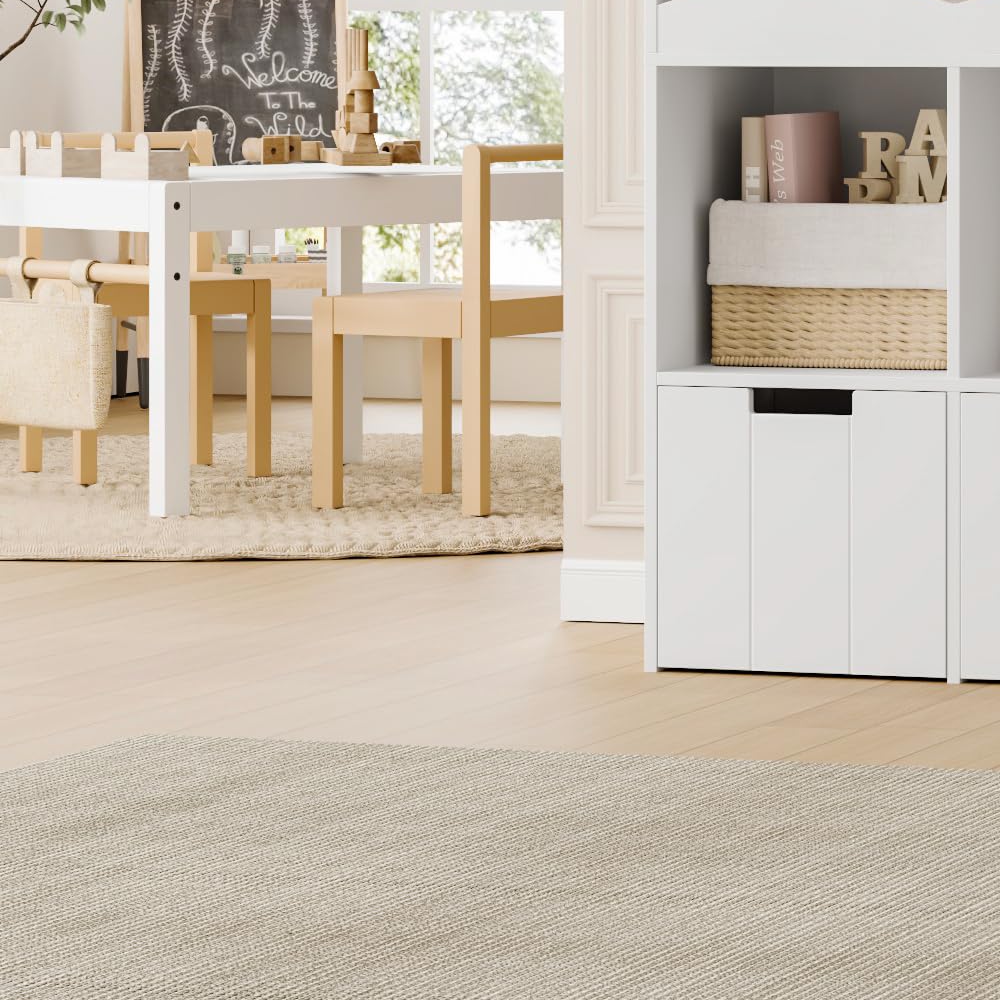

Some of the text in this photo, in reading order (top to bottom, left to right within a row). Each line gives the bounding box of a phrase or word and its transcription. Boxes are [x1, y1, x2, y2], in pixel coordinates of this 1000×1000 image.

[221, 51, 338, 90] Welcome
[257, 91, 316, 109] To The
[244, 112, 333, 138] Wild
[770, 139, 785, 184] Web
